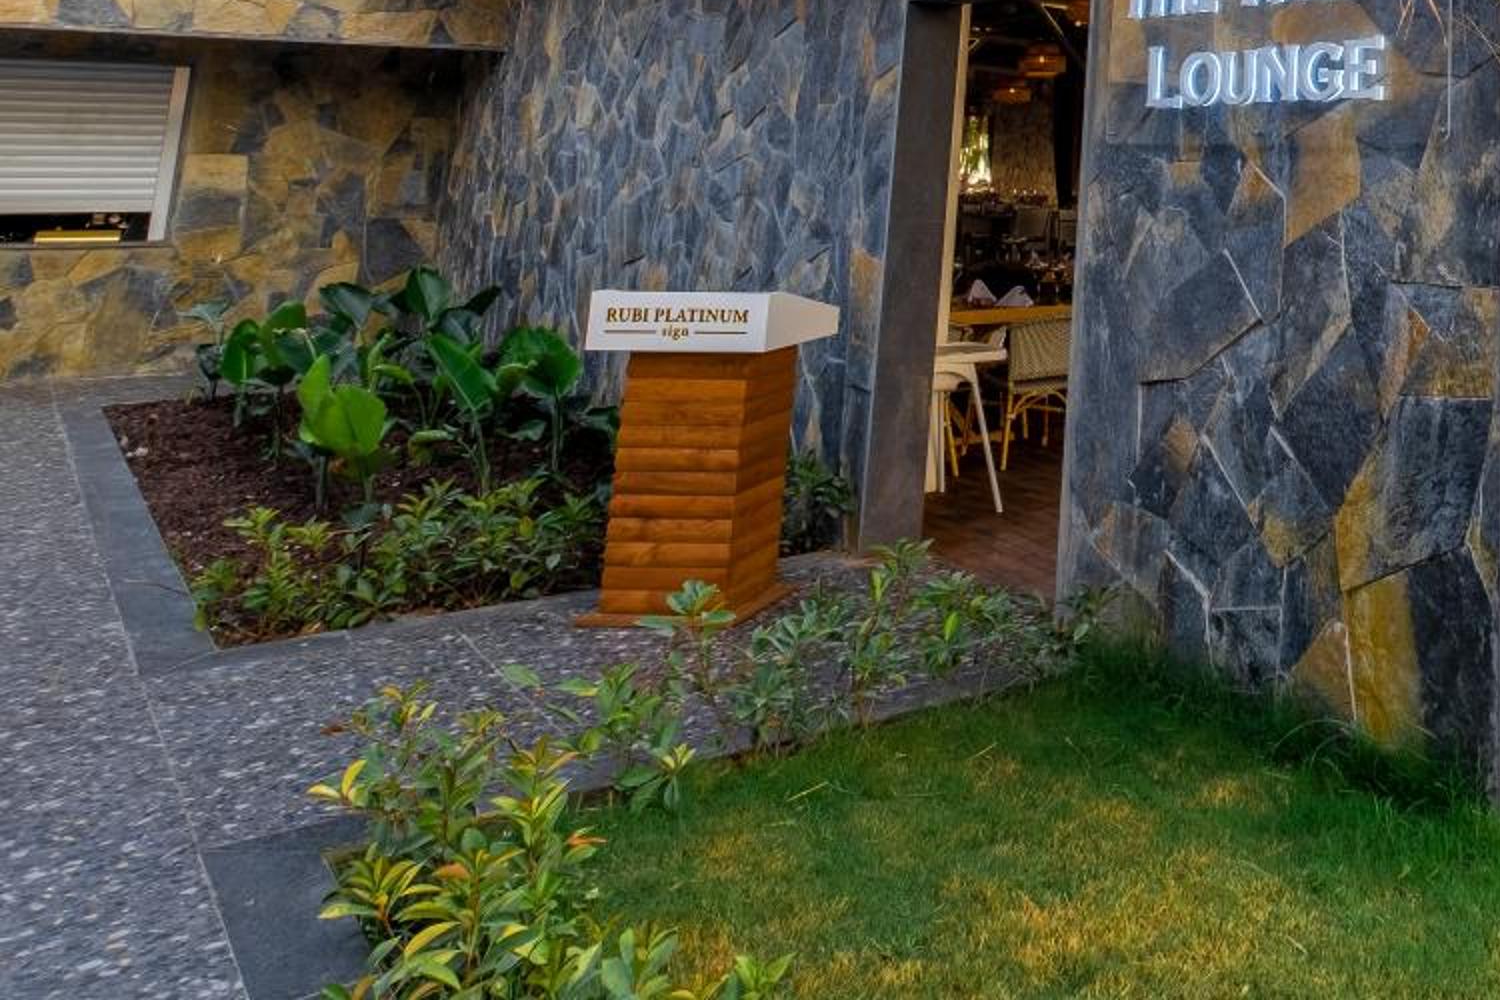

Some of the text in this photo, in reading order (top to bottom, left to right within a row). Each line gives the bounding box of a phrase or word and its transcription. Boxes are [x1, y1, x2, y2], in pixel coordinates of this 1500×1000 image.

[1146, 35, 1385, 108] LOUNGE
[606, 307, 749, 323] RUBI PLATINUM
